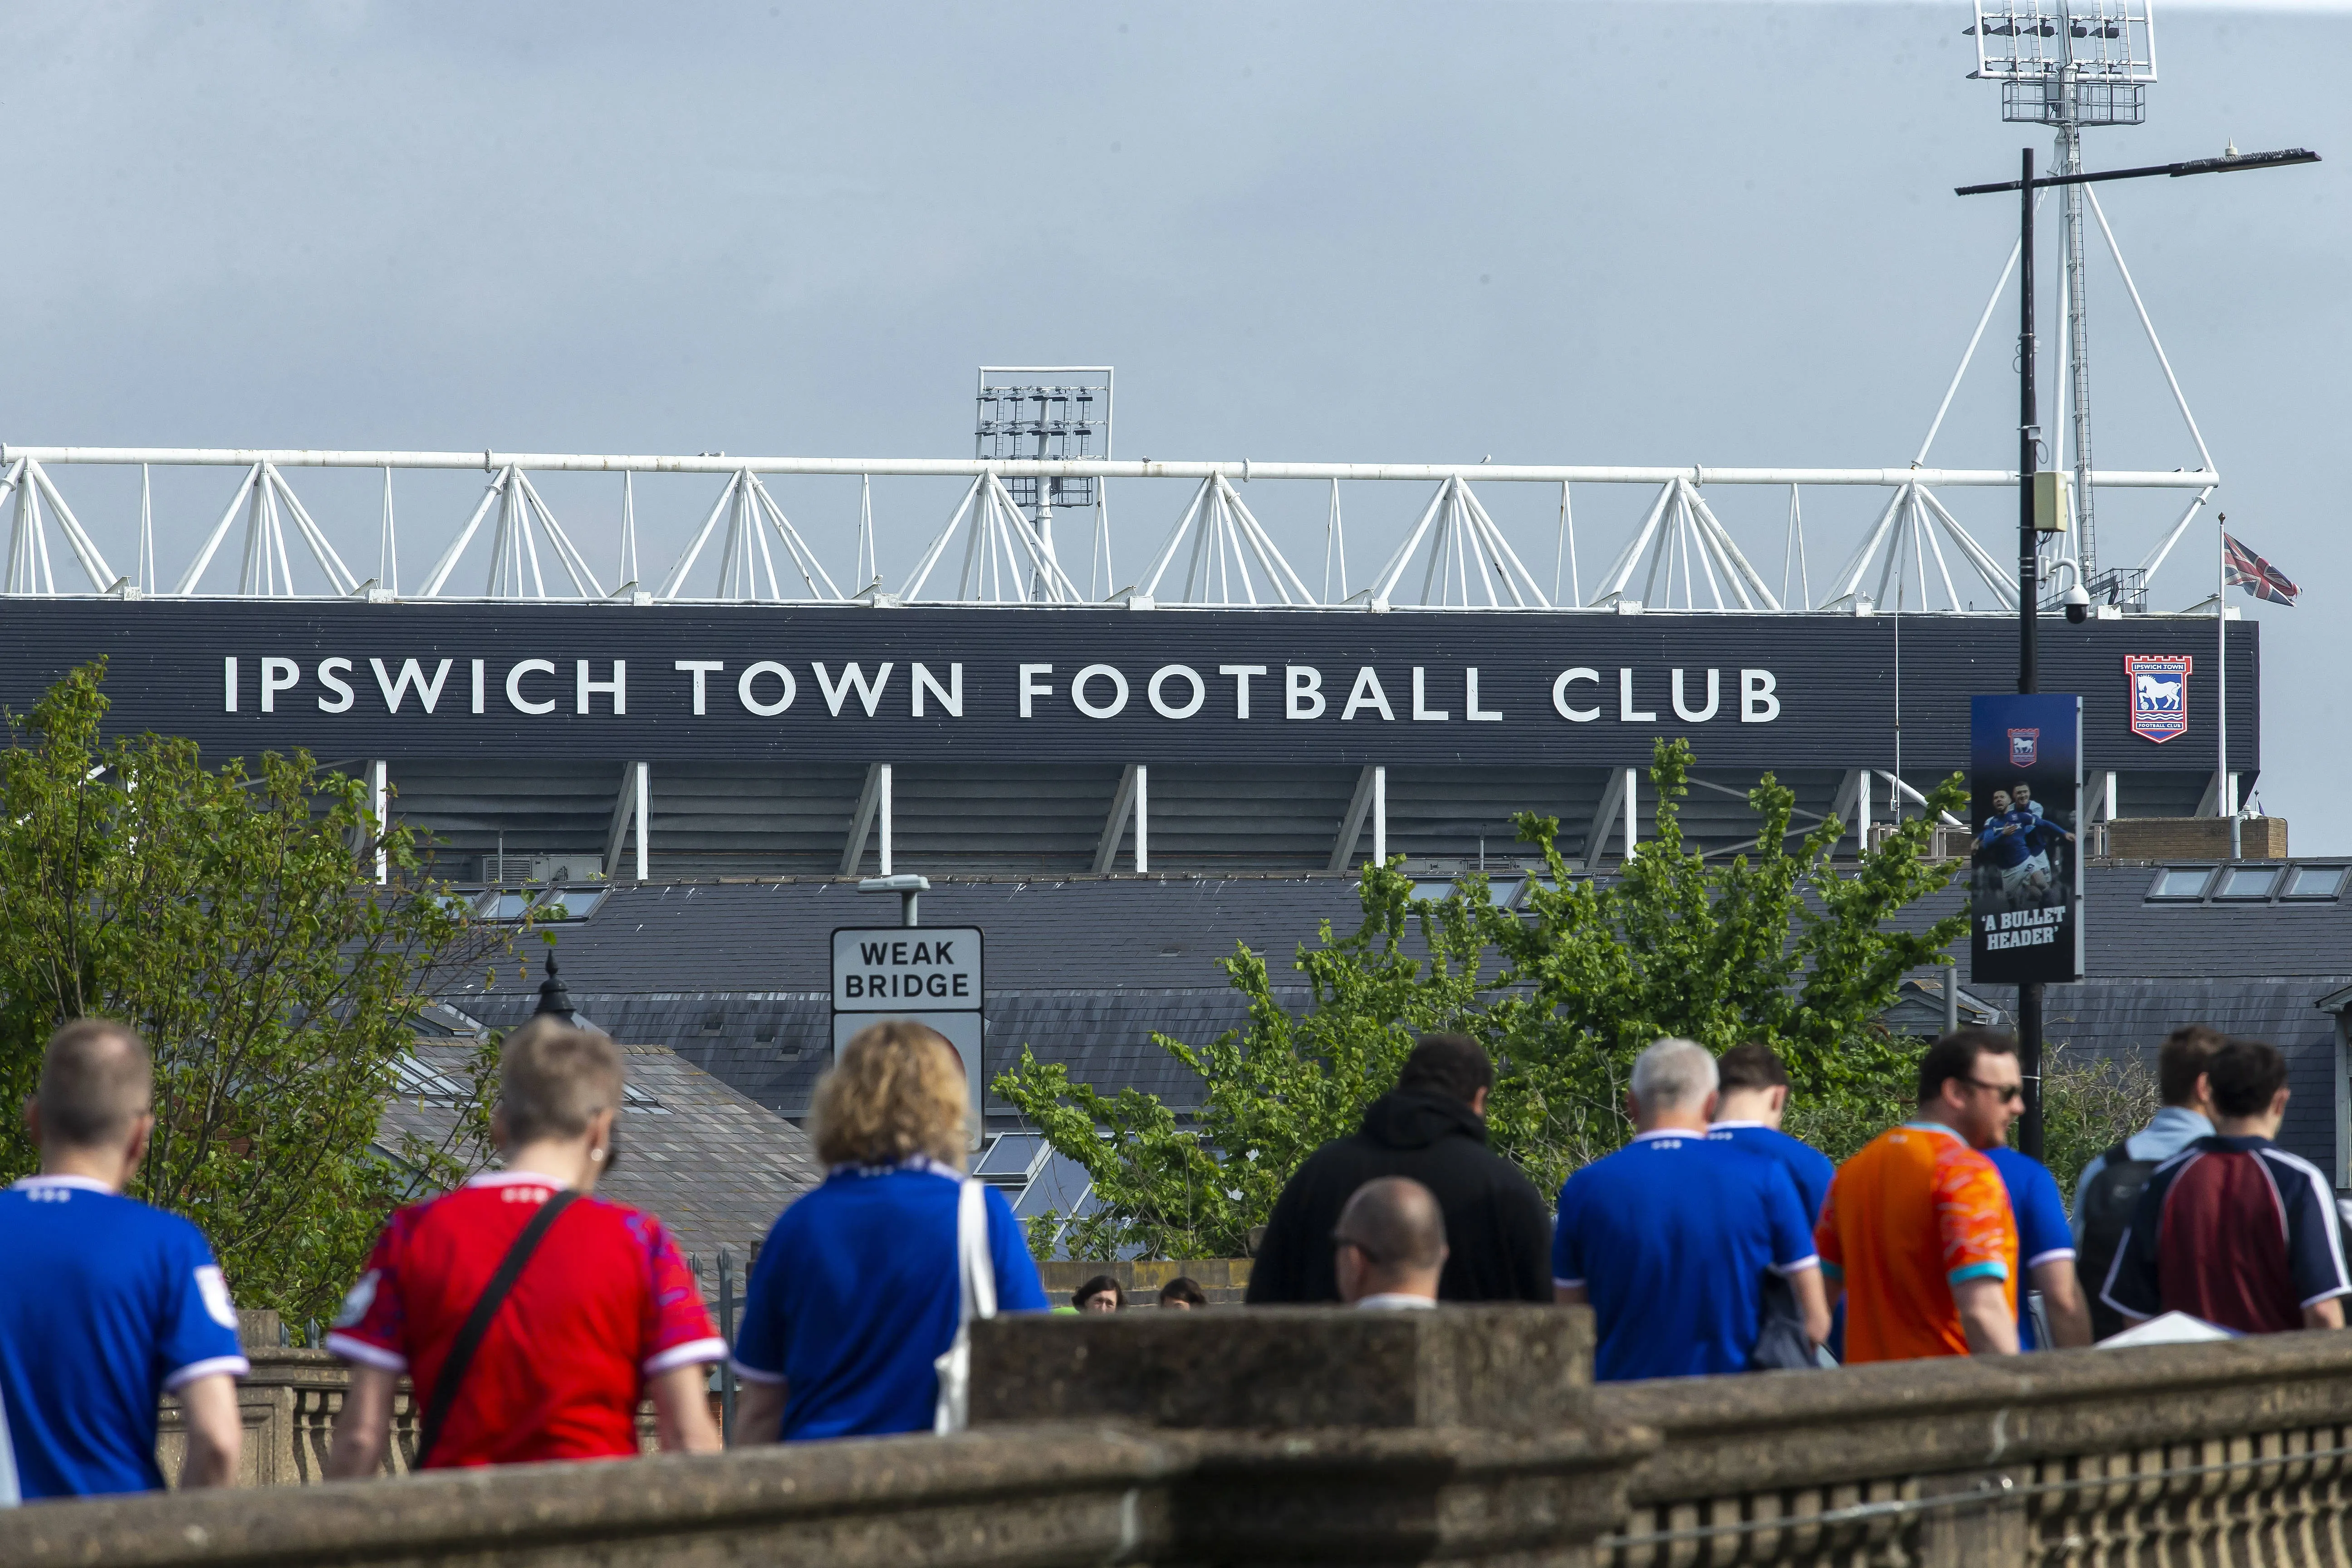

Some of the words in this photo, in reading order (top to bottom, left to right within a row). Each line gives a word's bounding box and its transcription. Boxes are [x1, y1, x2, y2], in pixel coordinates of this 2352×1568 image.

[225, 657, 626, 715] IPSWICH
[675, 660, 963, 717] TOWN
[1019, 664, 1503, 721] FOOTBALL
[1553, 667, 1781, 723] CLUB
[2000, 906, 2066, 930] BULLET
[860, 941, 954, 965] WEAK
[846, 974, 969, 998] BRIDGE
